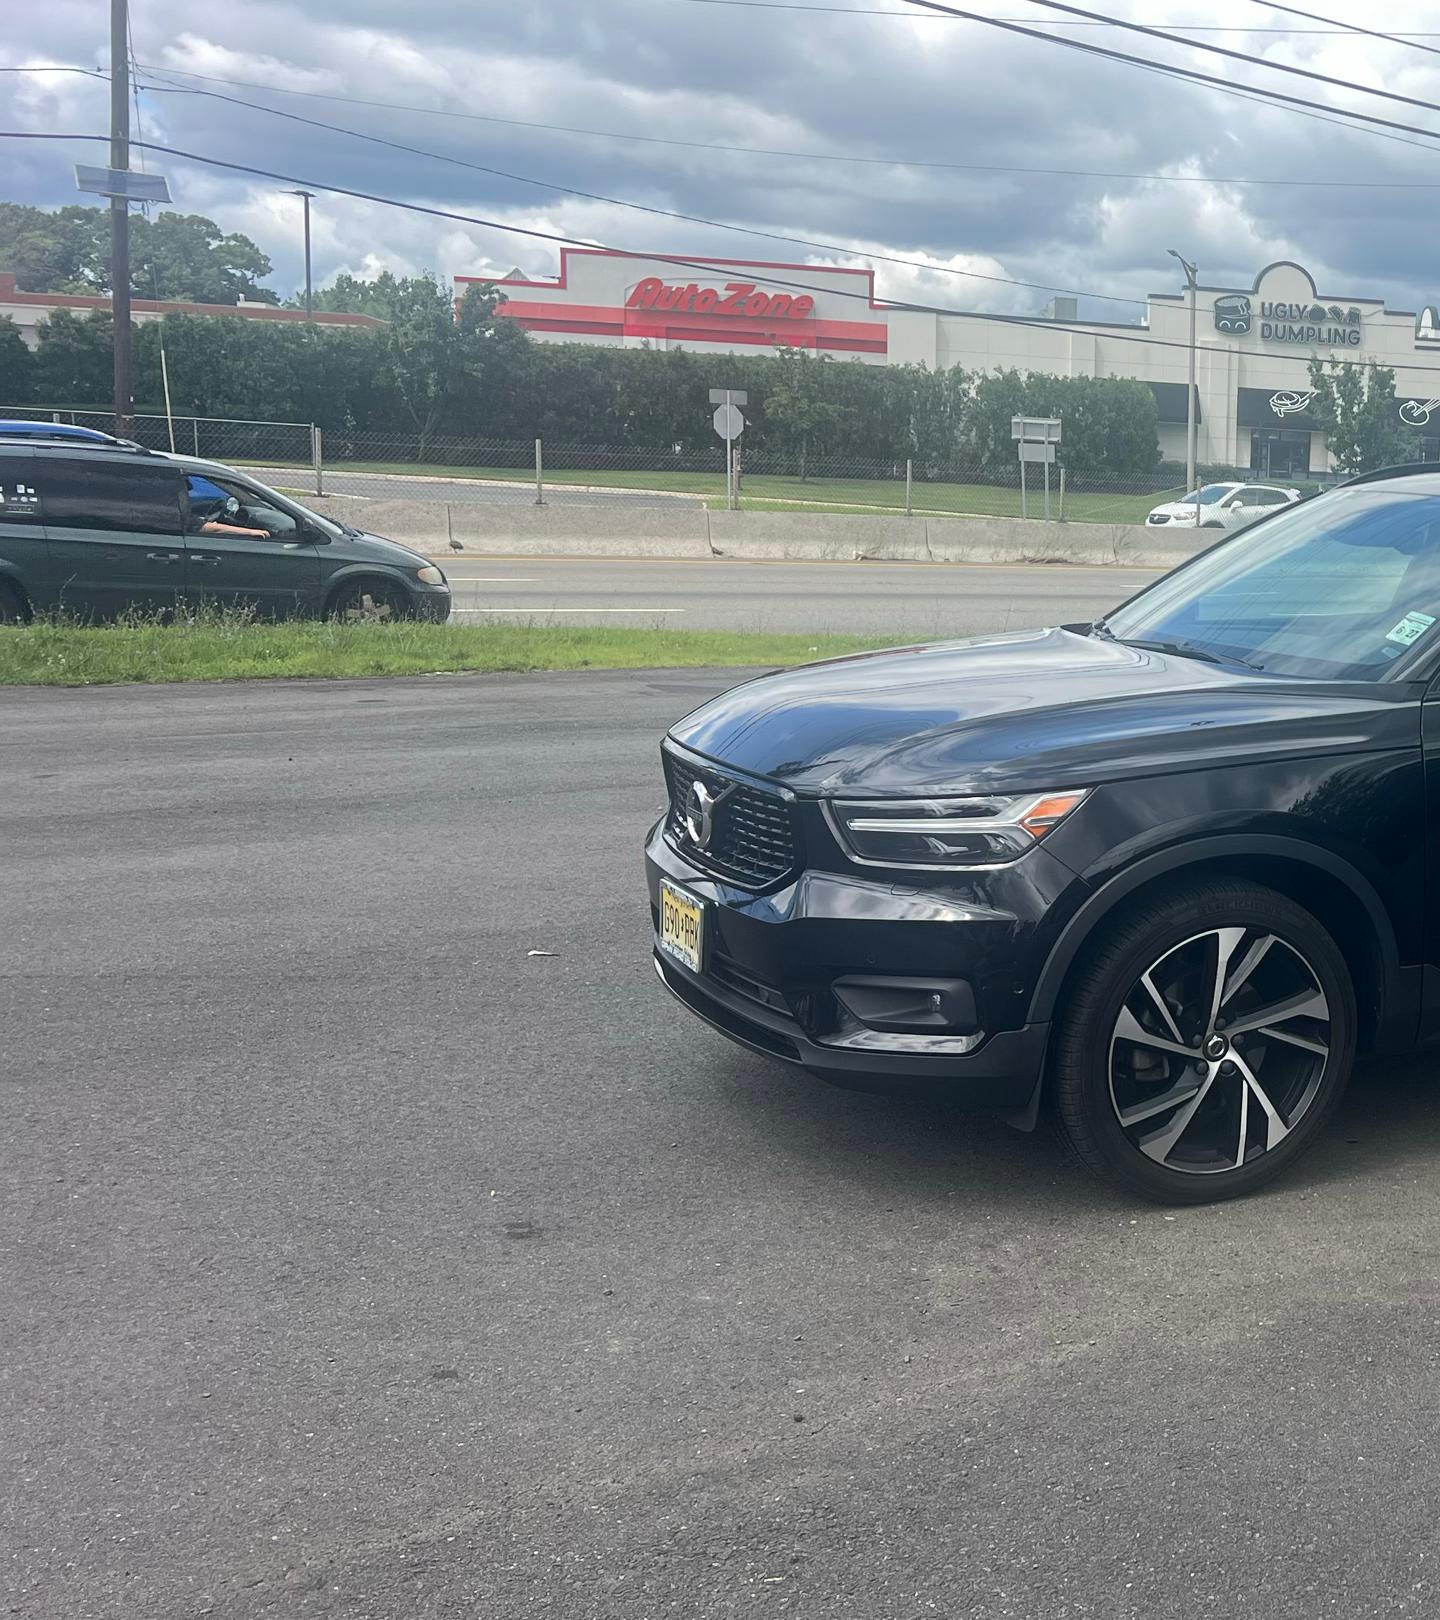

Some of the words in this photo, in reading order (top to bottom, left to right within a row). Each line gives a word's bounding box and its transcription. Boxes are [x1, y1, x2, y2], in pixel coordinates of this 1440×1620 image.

[626, 277, 815, 318] AutoZone
[1261, 302, 1308, 321] UGLY
[1261, 323, 1361, 345] DUMPLING
